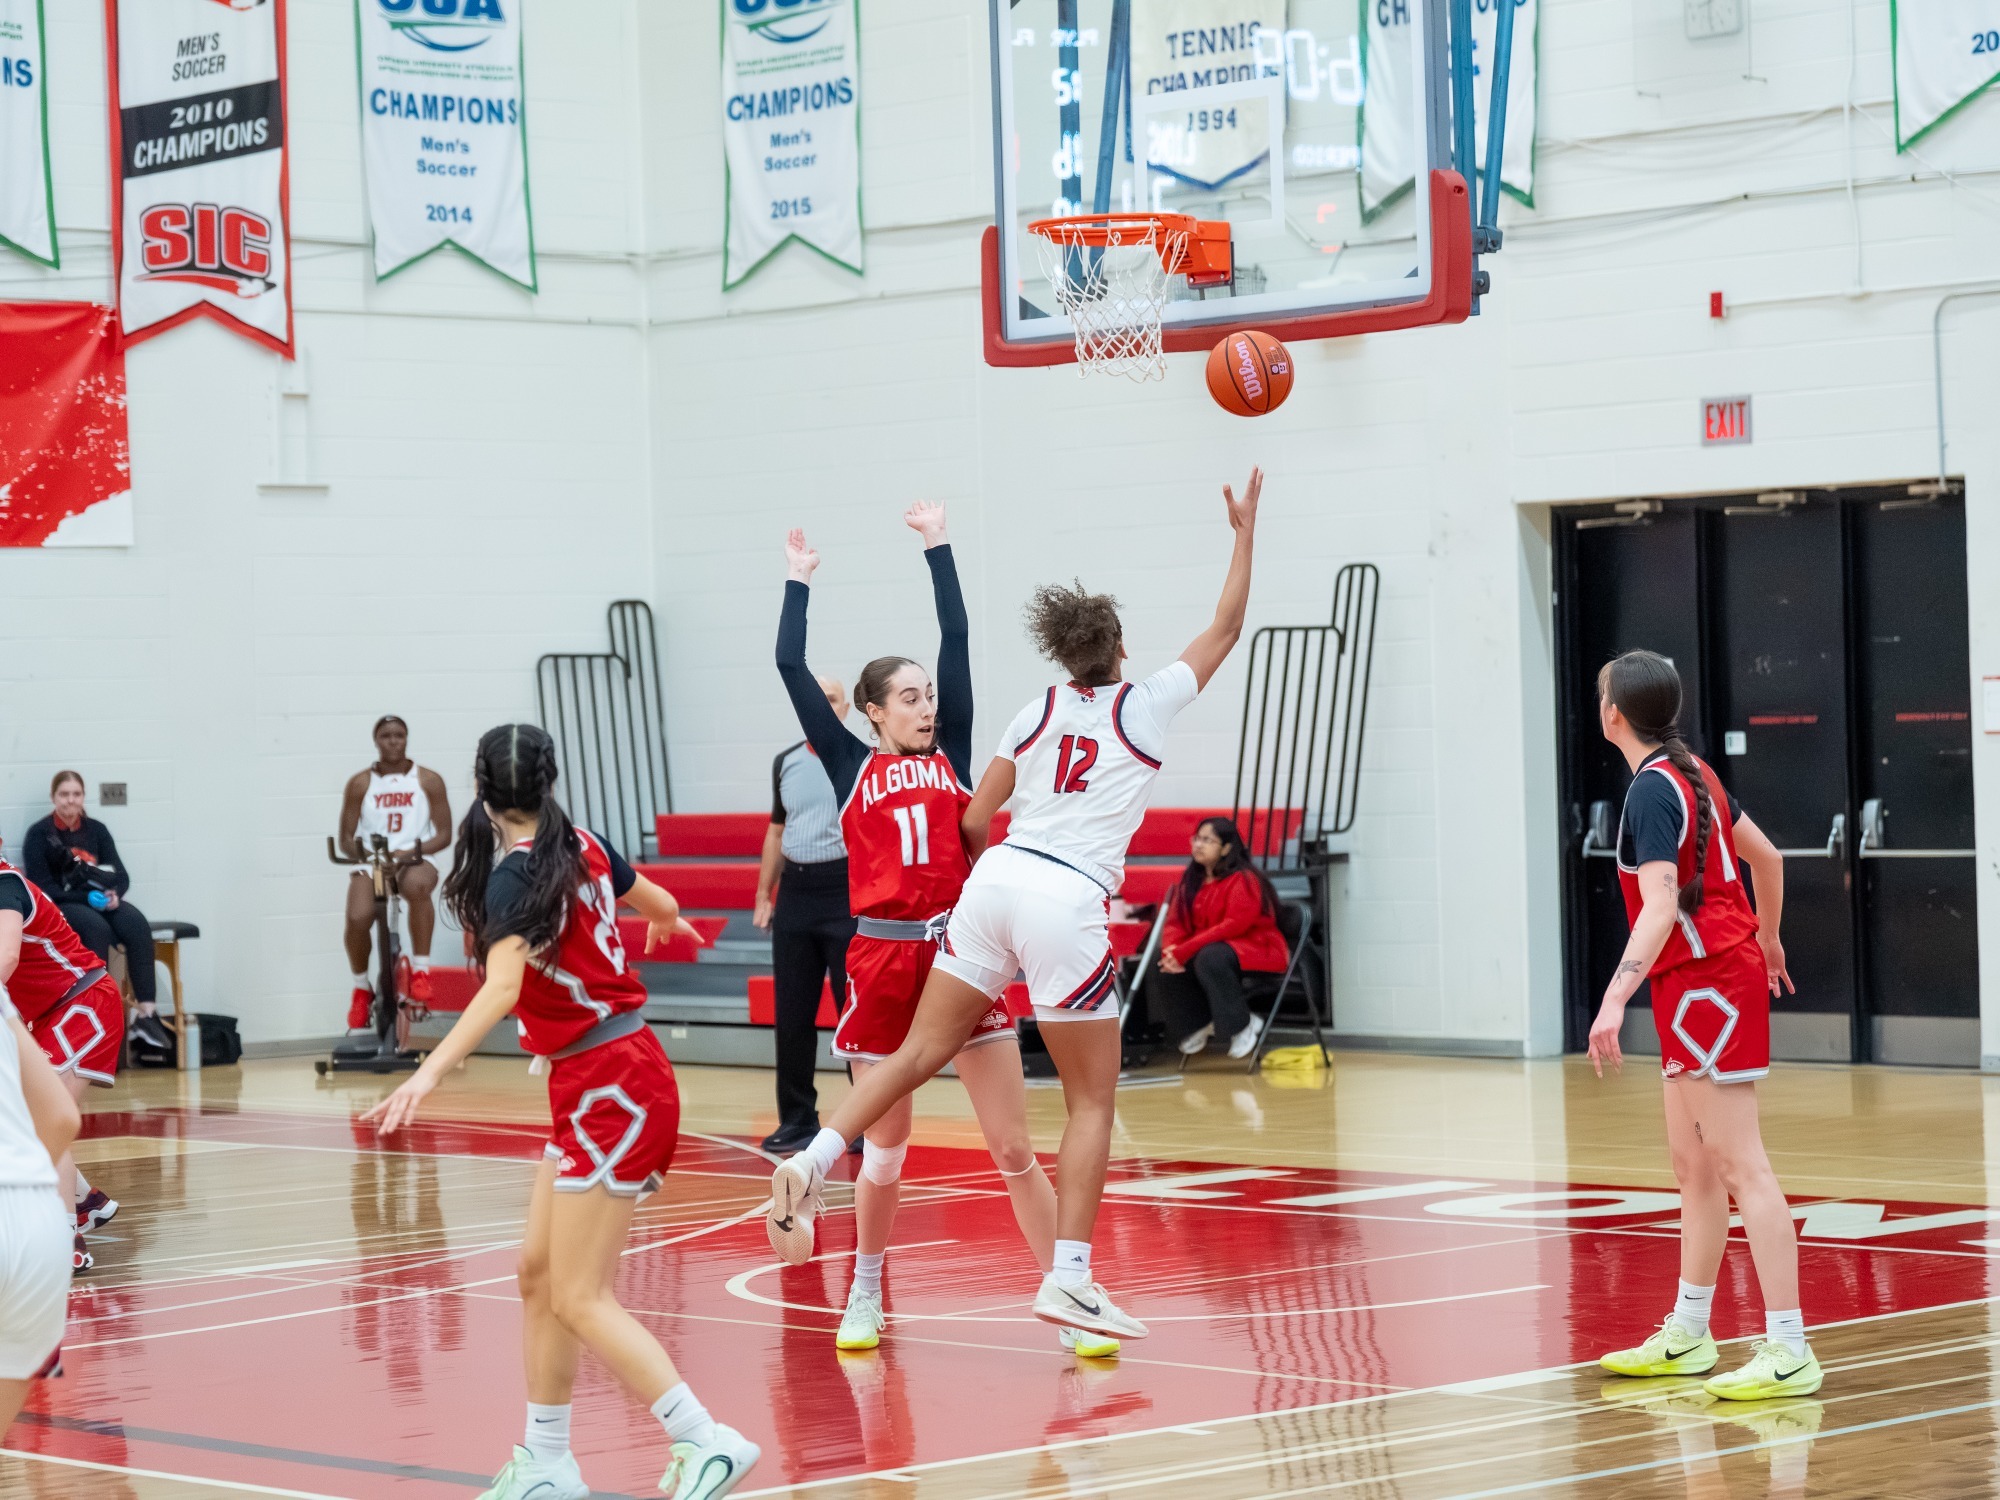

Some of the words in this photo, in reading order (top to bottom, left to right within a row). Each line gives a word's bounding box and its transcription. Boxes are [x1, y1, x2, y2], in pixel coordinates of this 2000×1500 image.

[177, 32, 220, 58] MEN'S
[1165, 21, 1262, 60] TENNIS
[172, 54, 226, 82] SOCCER
[169, 98, 234, 129] 2010
[370, 88, 518, 125] CHAMPIONS
[727, 77, 853, 122] CHAMPIONS
[1186, 107, 1237, 131] 1994
[133, 117, 269, 169] CHAMPIONS
[421, 136, 470, 153] Men's
[769, 130, 812, 149] Men's
[416, 158, 477, 176] Soccer
[764, 153, 817, 171] Soccer
[426, 204, 473, 223] 2014
[770, 198, 812, 219] 2015
[141, 203, 272, 279] SIC
[1235, 340, 1263, 400] Wilson
[1705, 401, 1746, 439] EXIT
[1054, 734, 1099, 793] 12
[861, 758, 957, 813] ALGOMA
[373, 792, 414, 809] YORK
[387, 812, 403, 833] 13
[893, 803, 930, 867] 11
